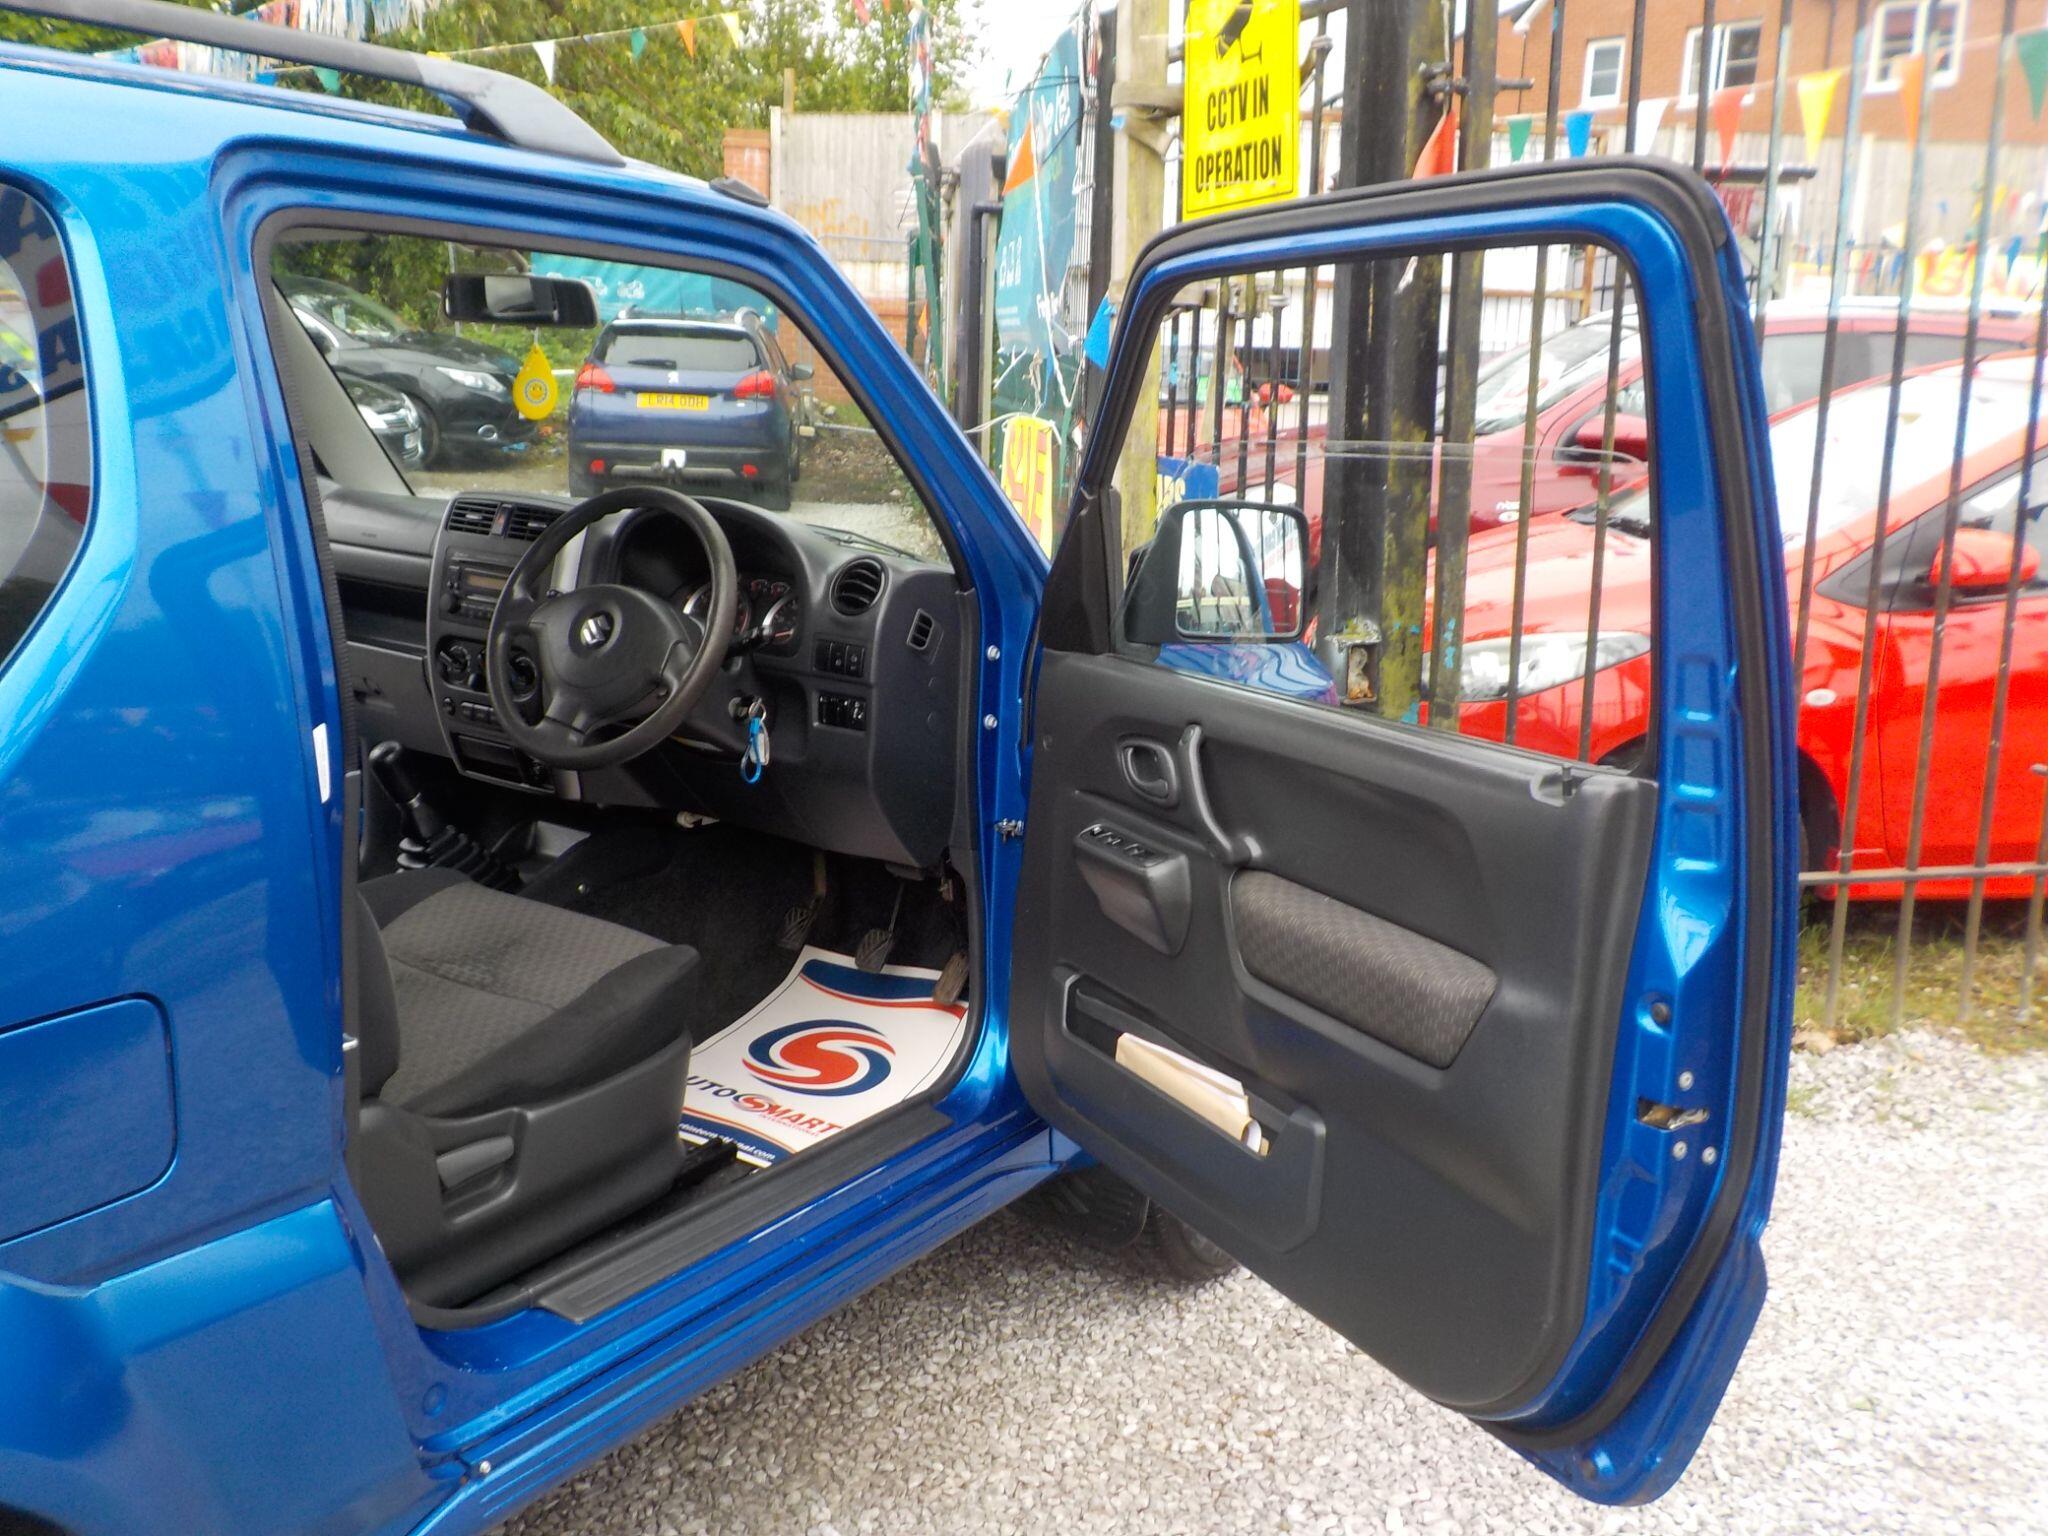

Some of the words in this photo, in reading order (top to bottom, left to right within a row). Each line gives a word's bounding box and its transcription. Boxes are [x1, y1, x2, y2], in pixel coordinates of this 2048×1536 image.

[1206, 81, 1249, 132] CCTV
[1252, 73, 1269, 119] IN
[1195, 135, 1282, 194] OPERATION
[686, 1075, 843, 1133] UTOSMART
